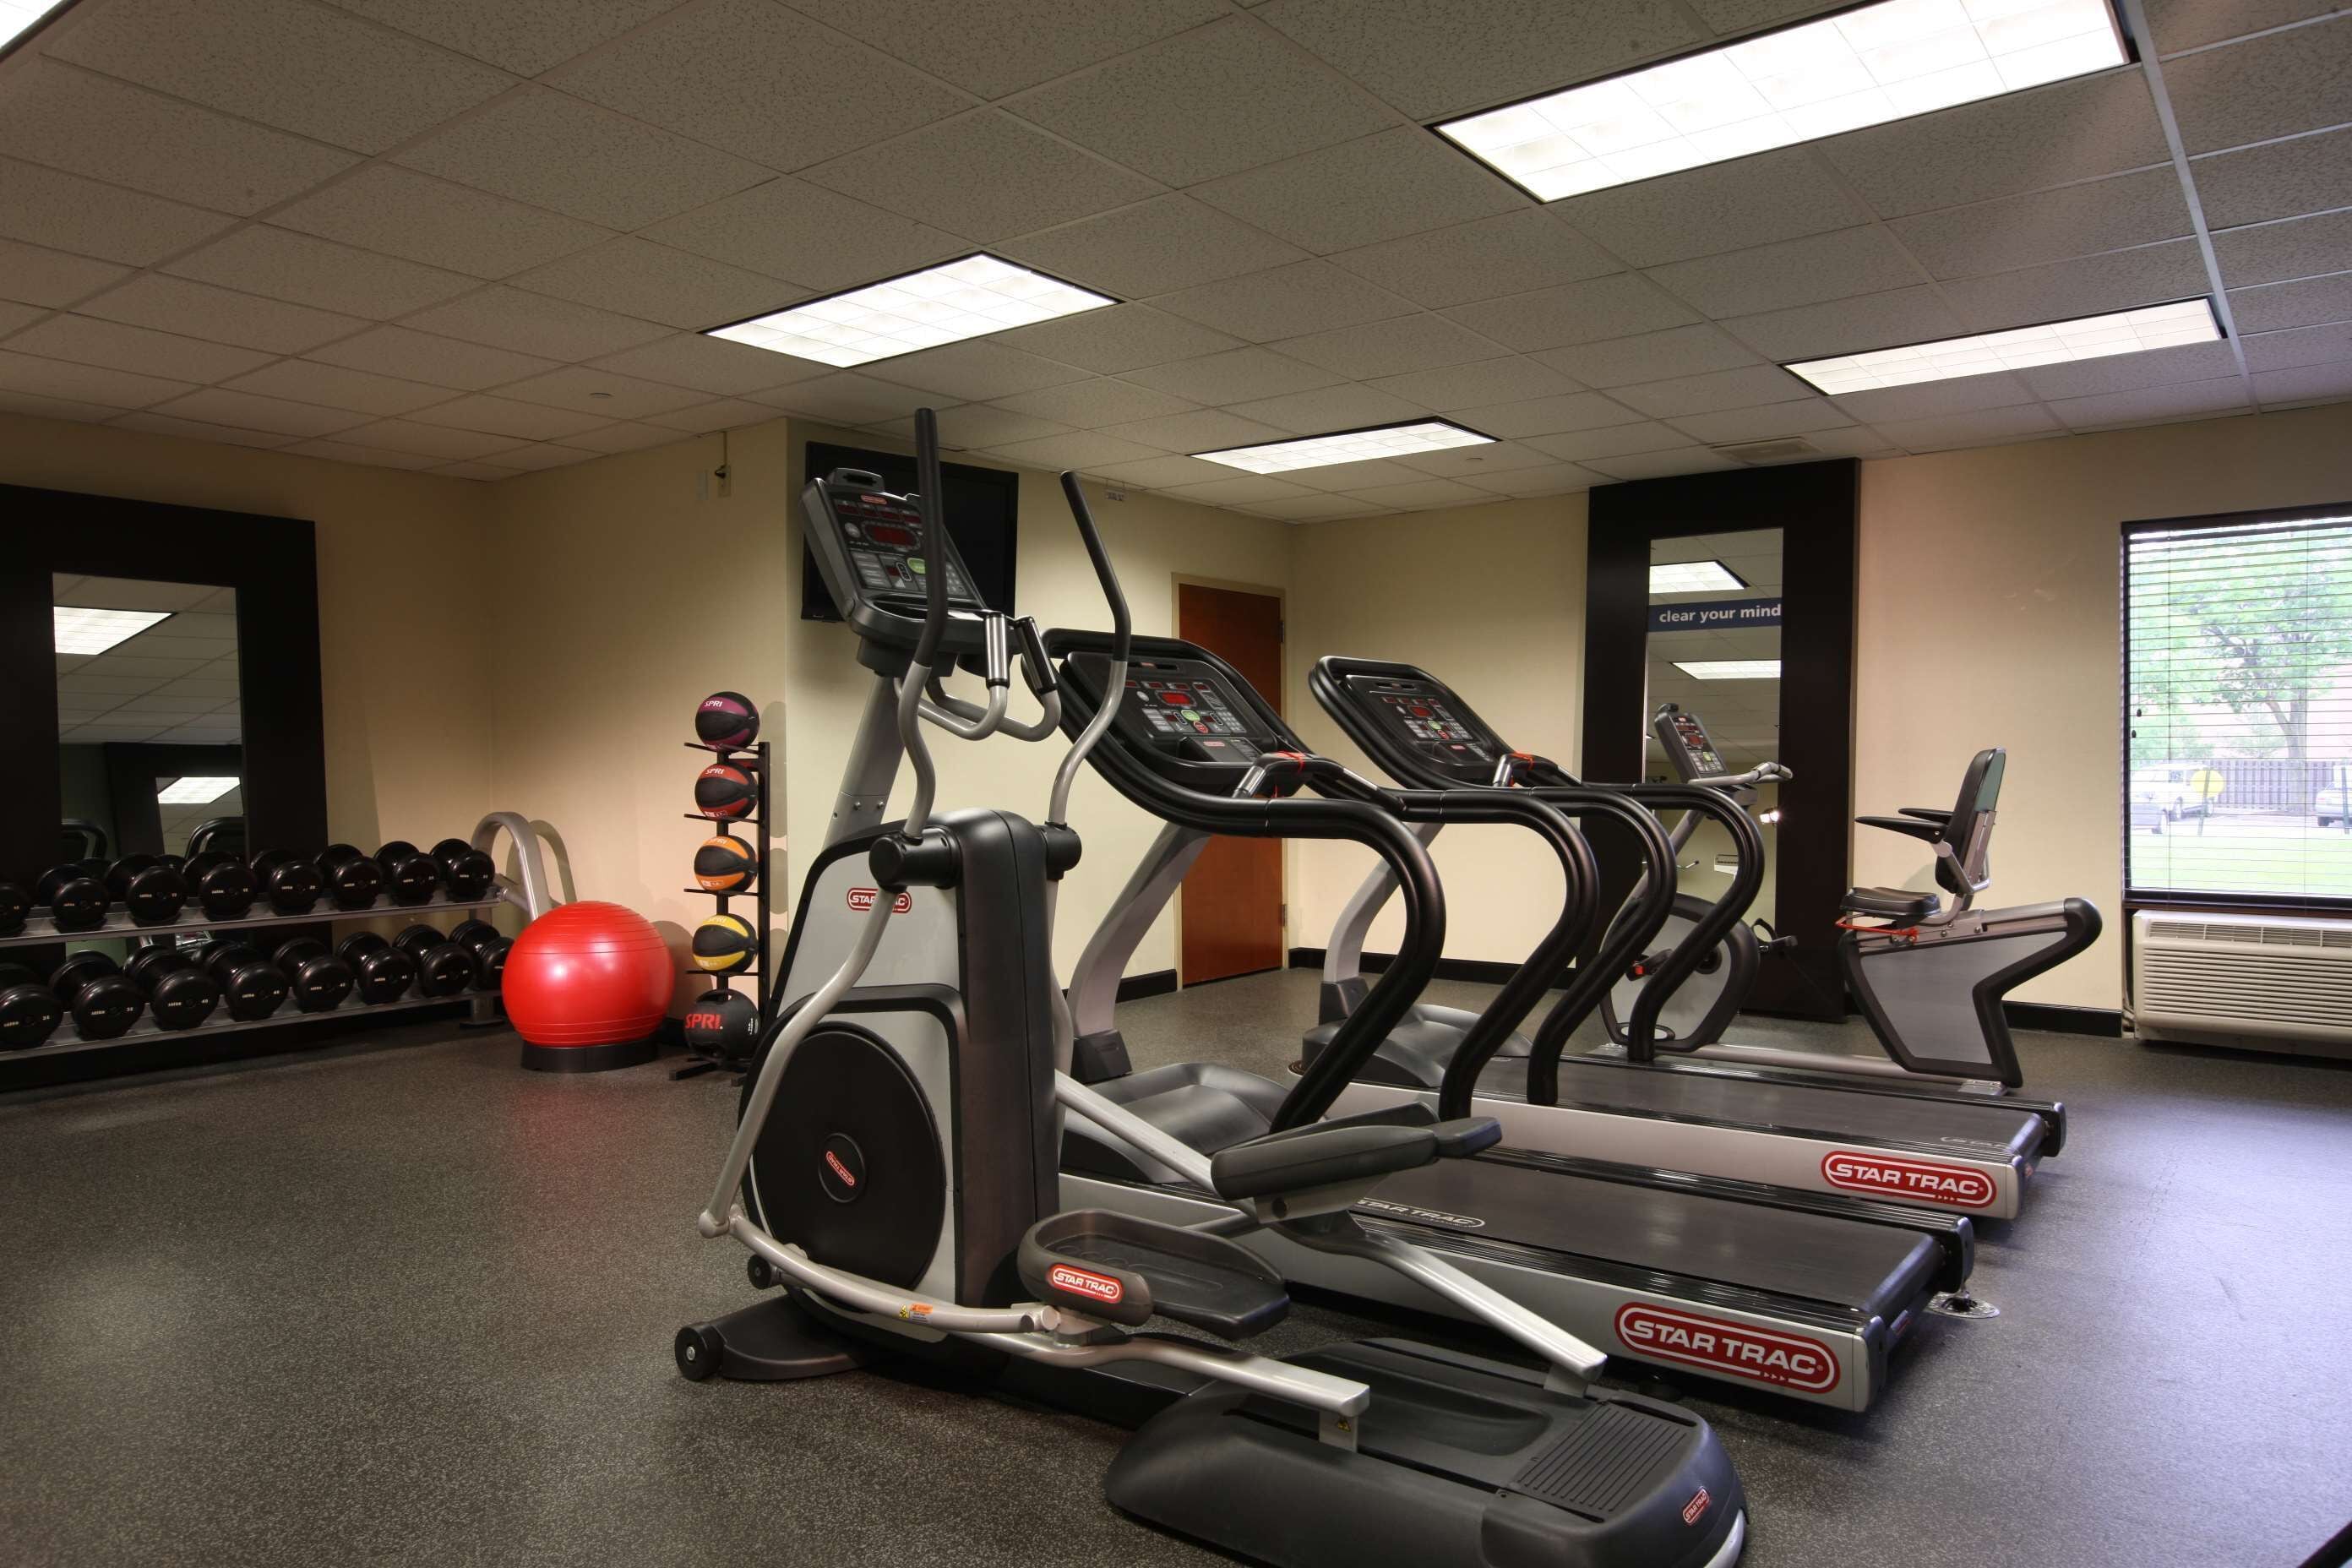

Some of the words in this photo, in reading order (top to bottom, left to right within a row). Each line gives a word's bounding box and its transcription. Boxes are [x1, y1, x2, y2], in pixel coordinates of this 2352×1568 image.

[1658, 609, 1696, 623] clear
[1700, 607, 1736, 623] your
[1740, 603, 1782, 618] mind
[685, 1013, 721, 1030] SPRI
[1832, 1163, 1901, 1184] STAR
[1905, 1172, 1979, 1195] TRAC
[1357, 1199, 1409, 1212] STAR
[1412, 1209, 1473, 1224] TRAC
[1055, 1271, 1085, 1287] STAR
[1085, 1279, 1114, 1294] TRAC
[1627, 1319, 1716, 1353] STAR
[1721, 1337, 1818, 1375] TRAC
[1685, 1505, 1697, 1519] STAR
[1696, 1492, 1707, 1508] TRAC
